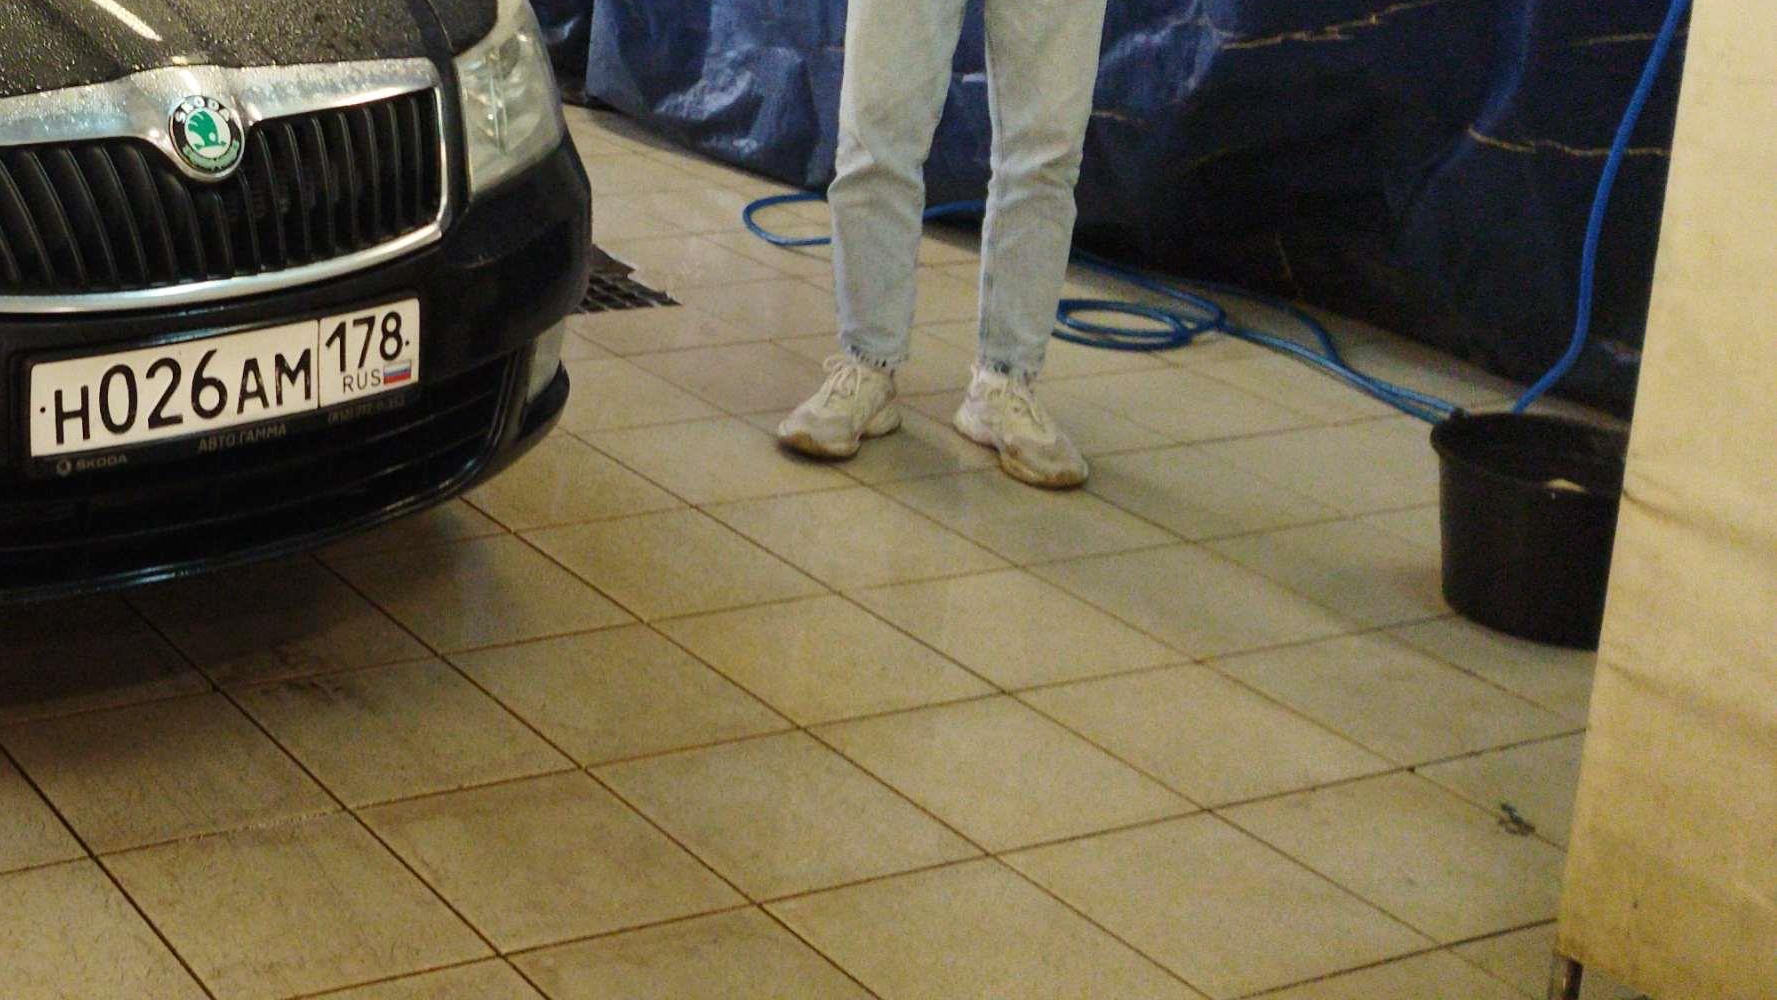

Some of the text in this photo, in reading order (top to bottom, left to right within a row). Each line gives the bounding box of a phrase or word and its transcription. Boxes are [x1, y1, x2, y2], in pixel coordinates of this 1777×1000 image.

[54, 310, 404, 445] Н026АМ 178
[342, 368, 382, 394] RUS
